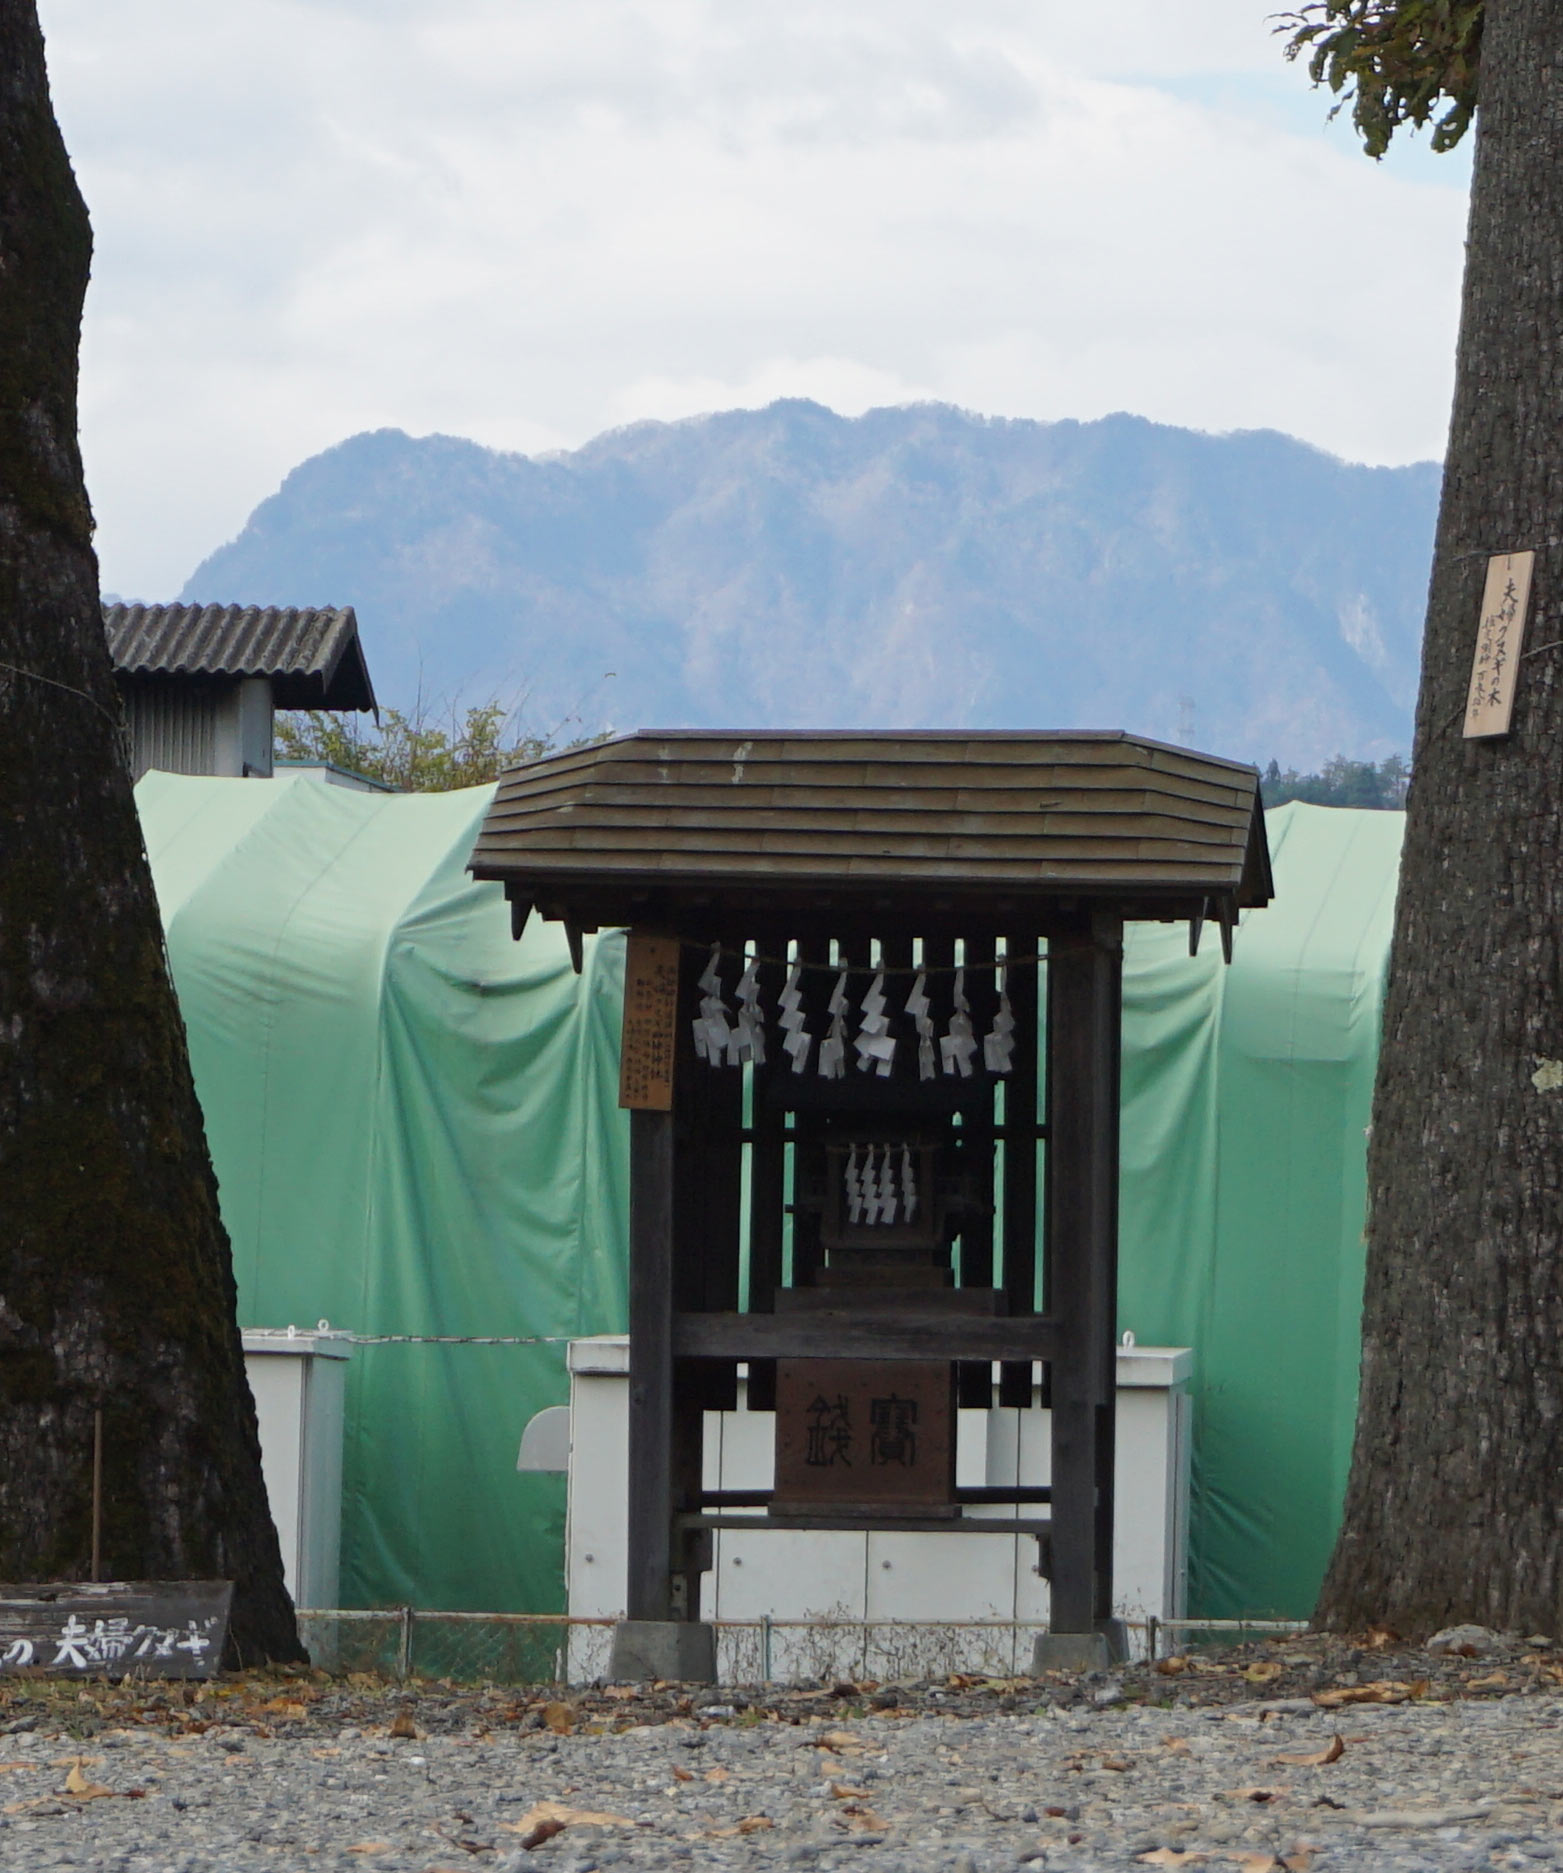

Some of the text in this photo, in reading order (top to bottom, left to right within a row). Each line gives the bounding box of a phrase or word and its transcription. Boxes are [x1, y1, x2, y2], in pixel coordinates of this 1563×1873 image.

[0, 1614, 218, 1668] の夫婦クヌギ
